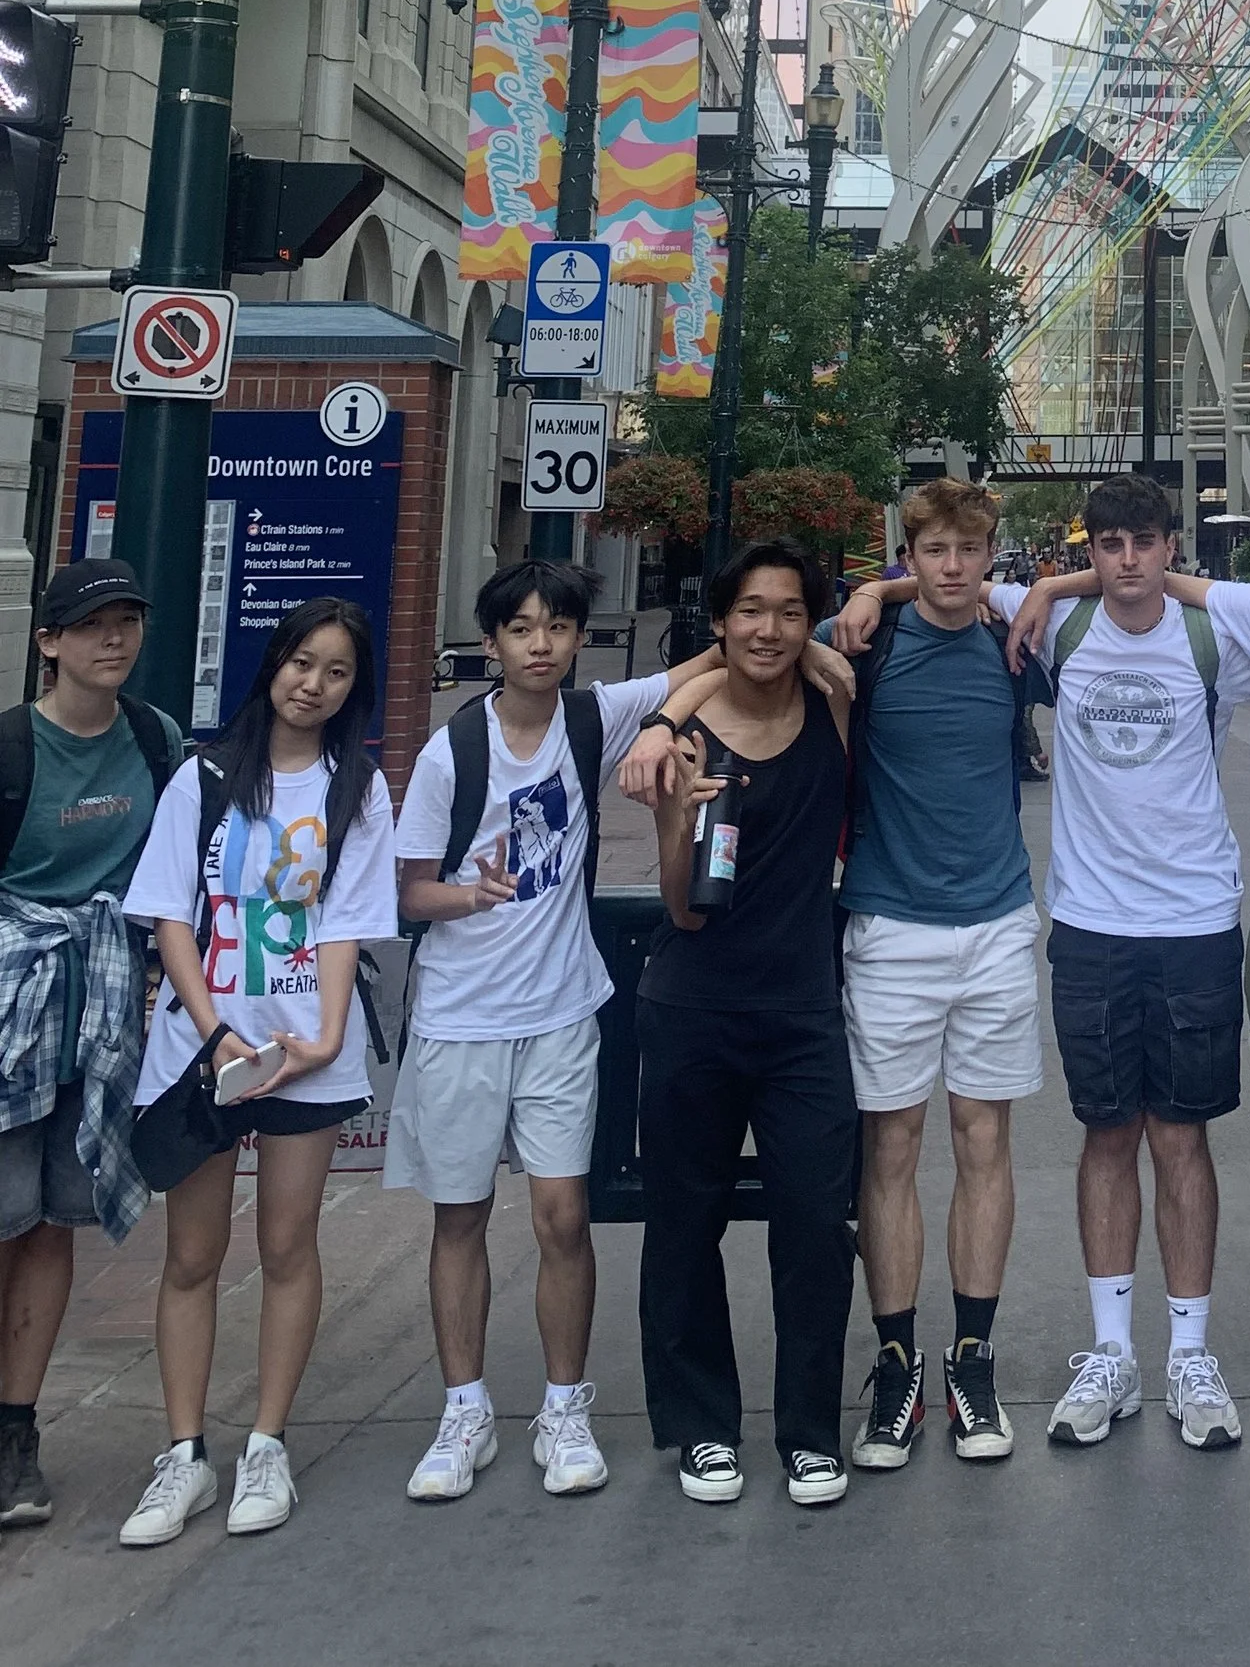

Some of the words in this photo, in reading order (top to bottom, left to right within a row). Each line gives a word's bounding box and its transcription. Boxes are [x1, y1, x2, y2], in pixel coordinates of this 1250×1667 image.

[499, 76, 546, 180] Avenue
[490, 136, 532, 224] Walk
[529, 327, 599, 341] 06:00-18:00
[534, 419, 600, 436] MAXIMUM
[207, 455, 318, 477] Downtown
[325, 455, 373, 477] Core
[530, 450, 599, 495] 30
[260, 525, 287, 535] CTrain
[288, 524, 323, 535] Stations
[330, 526, 344, 534] min
[245, 542, 262, 552] Eau
[263, 541, 287, 552] Claire
[243, 559, 277, 569] Prince's
[279, 559, 305, 569] Island
[306, 559, 326, 569] Park
[240, 599, 280, 609] Devonian
[239, 616, 280, 629] Shopping
[78, 794, 113, 807] EMBRACE
[60, 796, 132, 827] HARMONY
